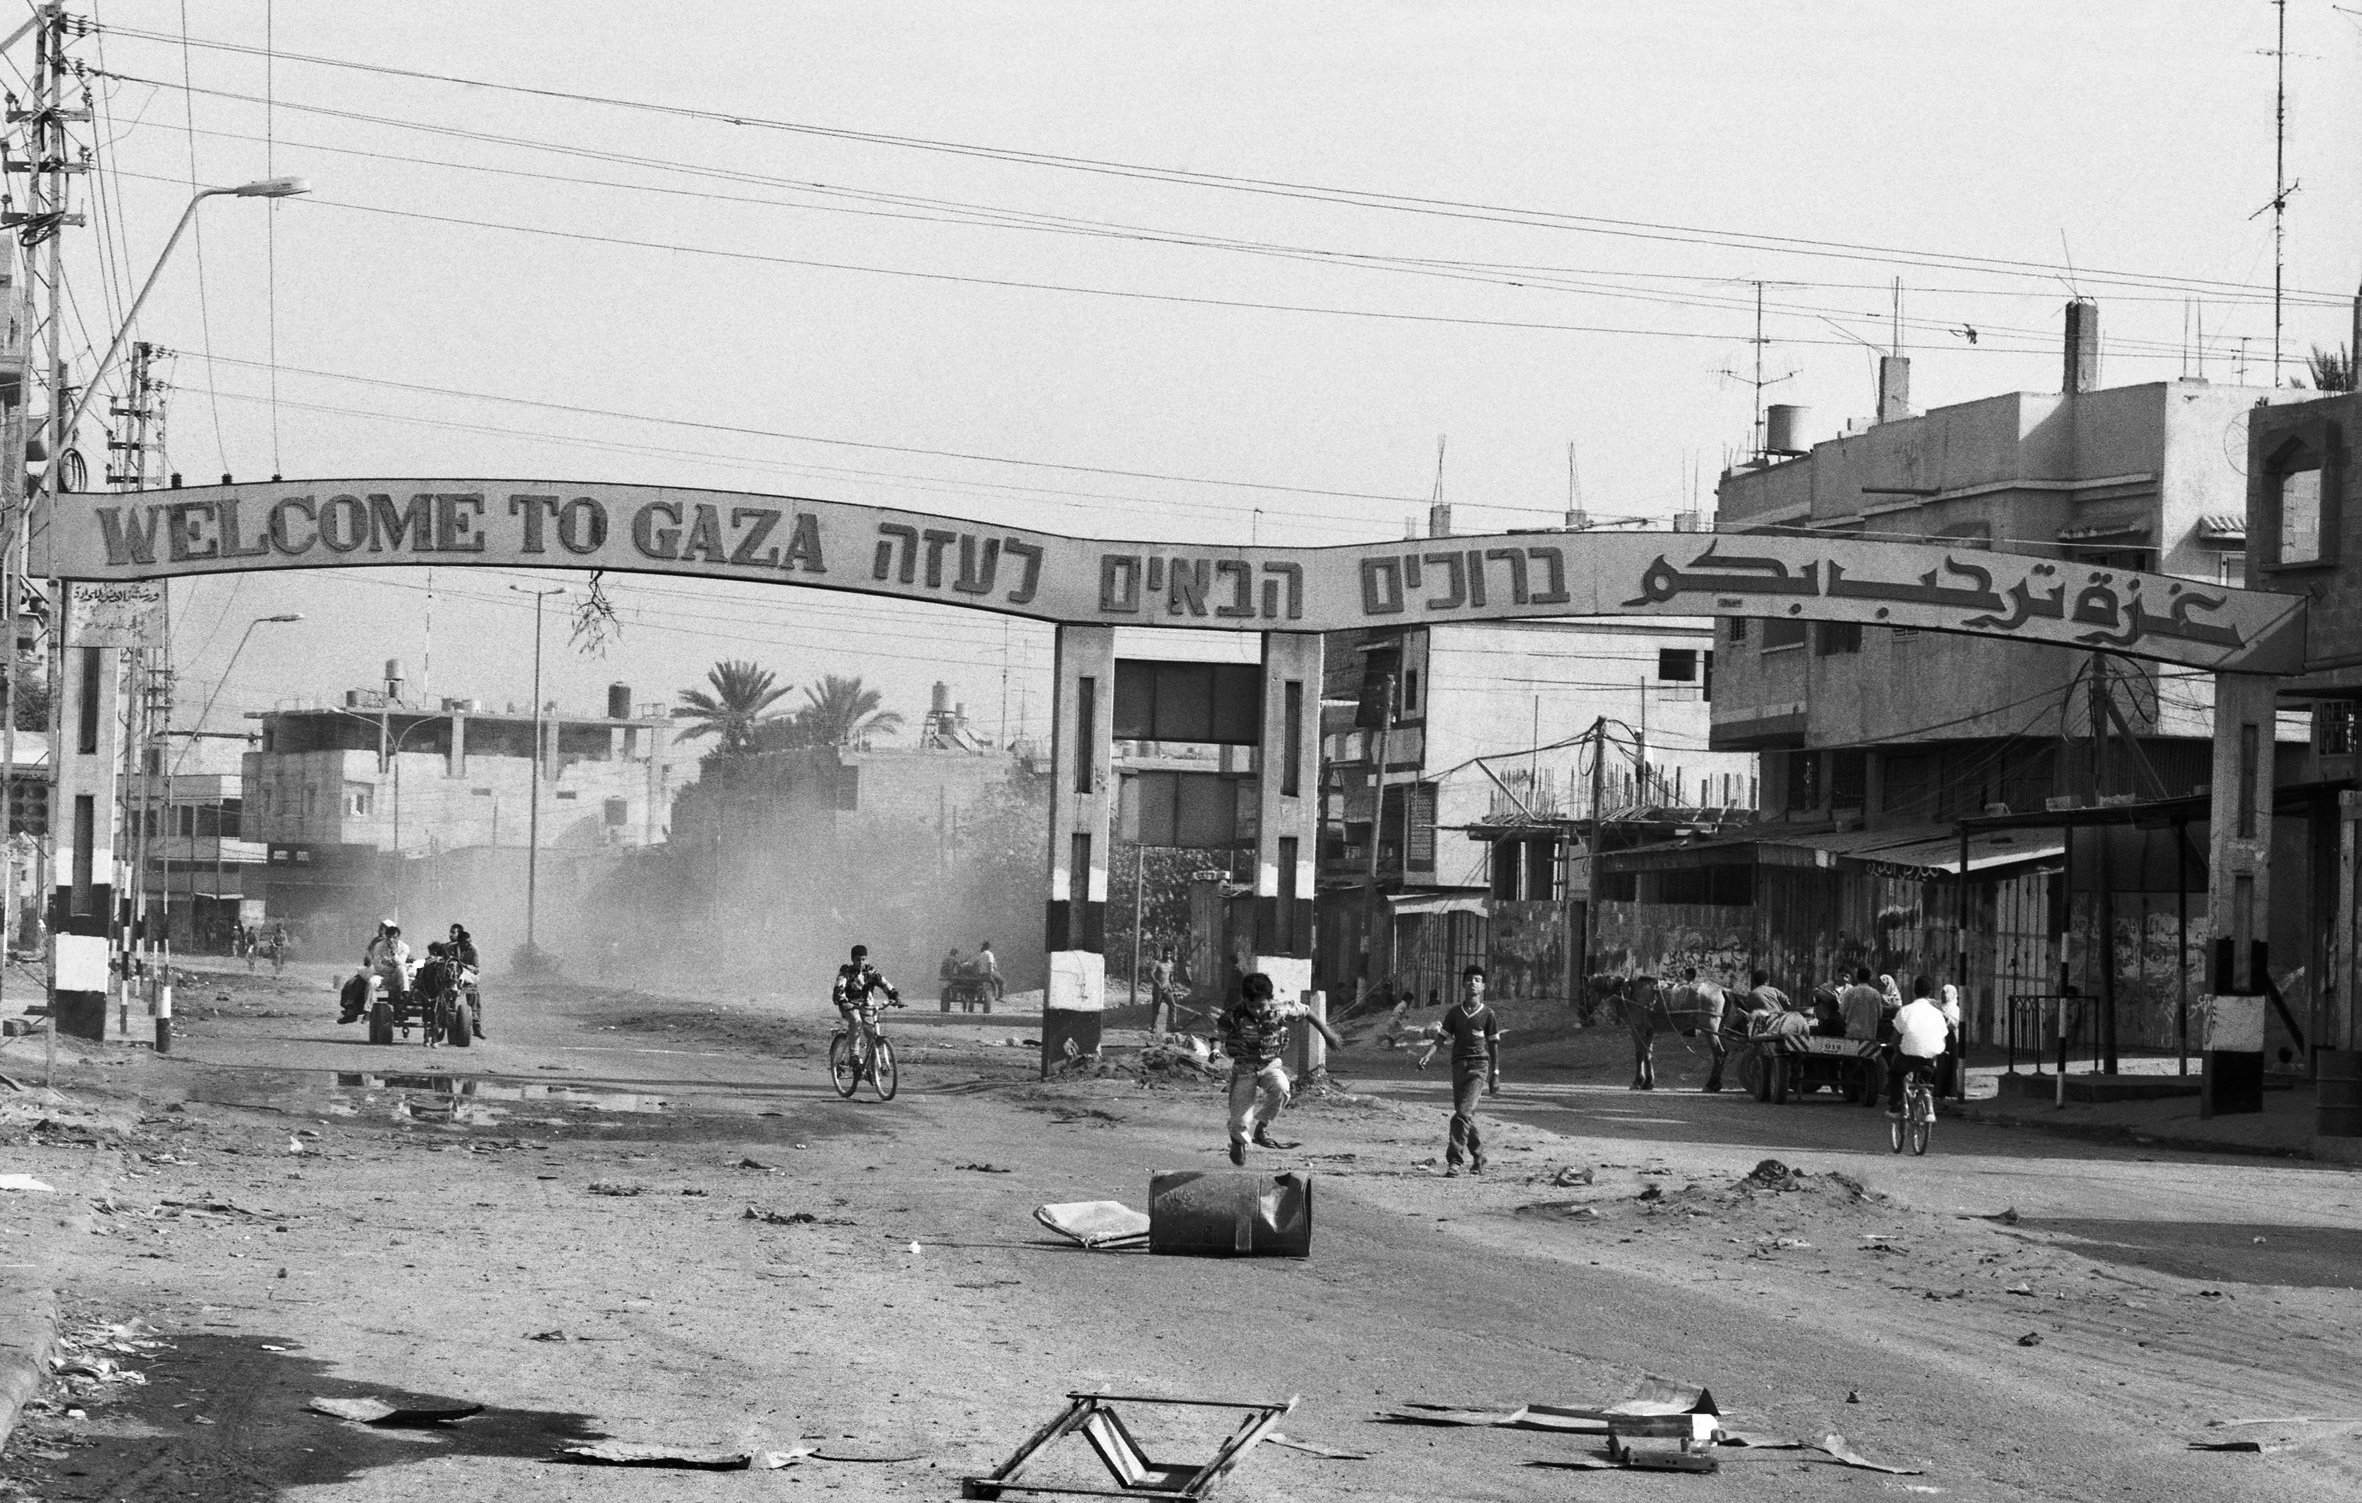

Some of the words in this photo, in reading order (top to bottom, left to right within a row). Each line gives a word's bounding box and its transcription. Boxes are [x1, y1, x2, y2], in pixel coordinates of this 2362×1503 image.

[97, 493, 485, 565] WELCOME
[510, 494, 608, 554] TO
[632, 501, 828, 572] GAZA
[873, 521, 1044, 604] לעזה
[1100, 553, 1304, 619] הבאים
[1361, 546, 1571, 615] ברוכים
[1621, 539, 1820, 614] بكم
[1826, 555, 2066, 629] ترحب
[2074, 572, 2245, 649] غزة
